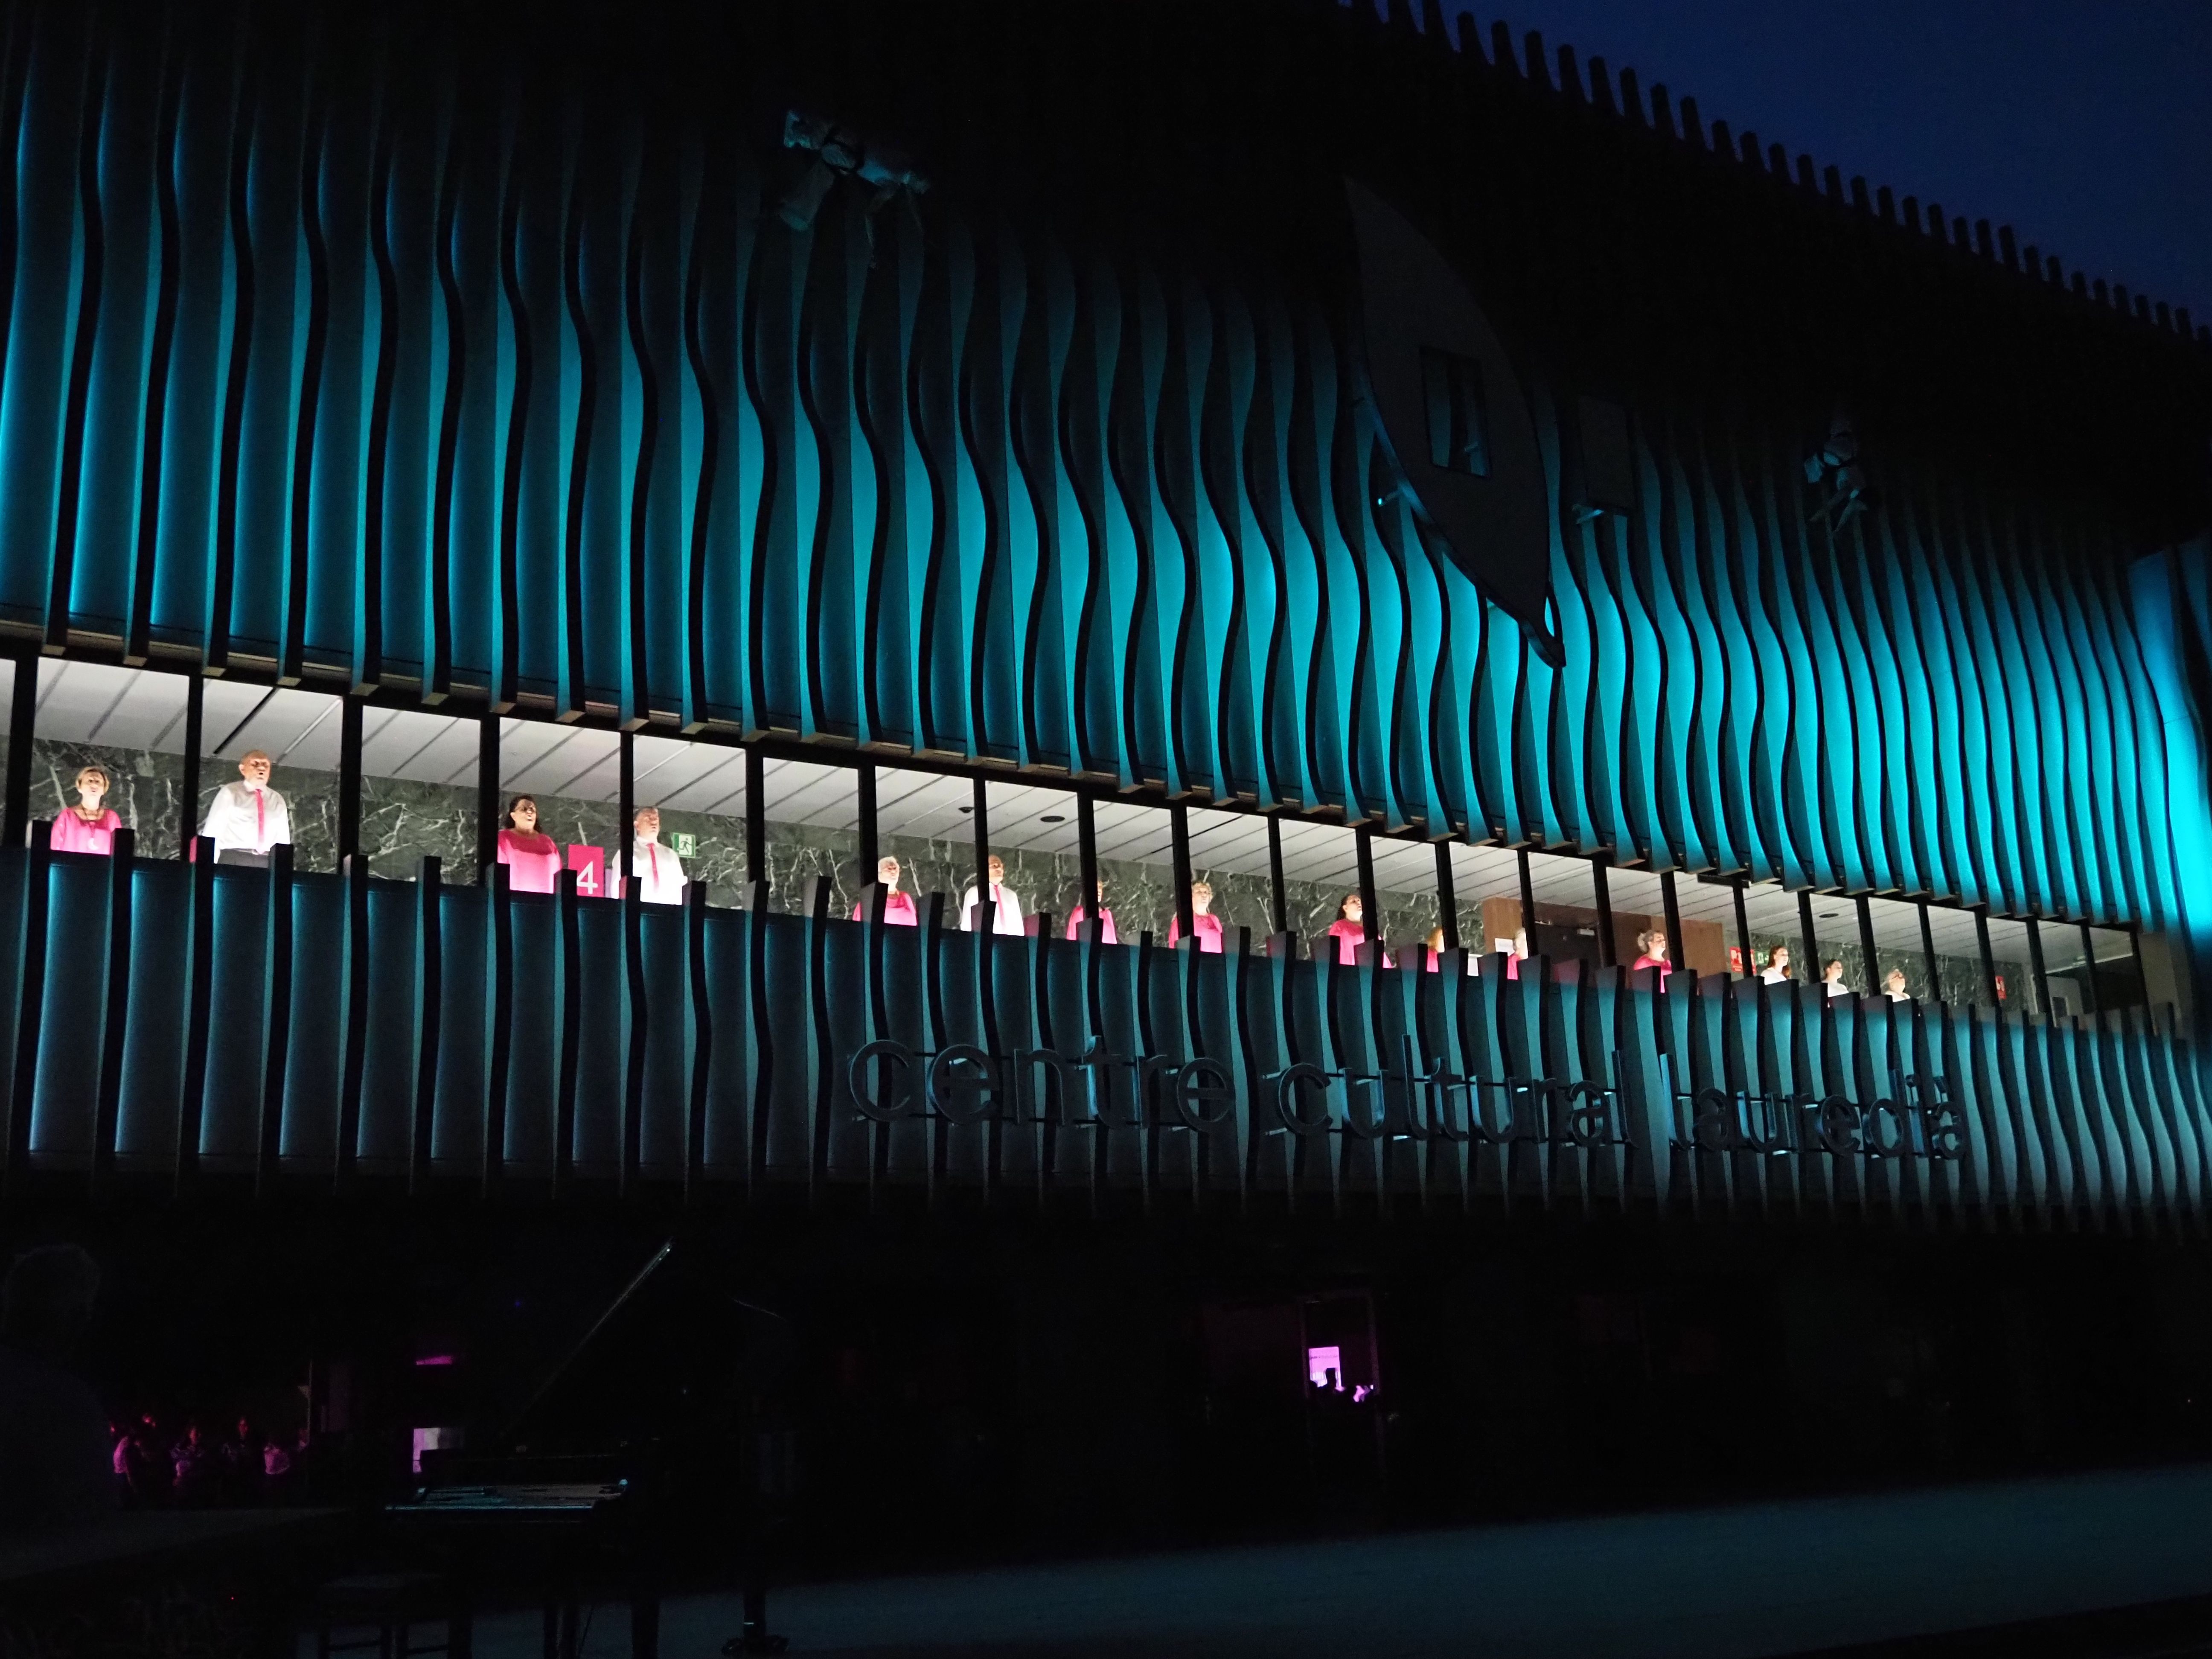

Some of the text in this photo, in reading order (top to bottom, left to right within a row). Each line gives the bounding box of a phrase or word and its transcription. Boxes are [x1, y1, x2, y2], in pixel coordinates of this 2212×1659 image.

[576, 861, 598, 894] 4
[849, 1035, 1235, 1132] centre
[1279, 1035, 1639, 1149] cultural
